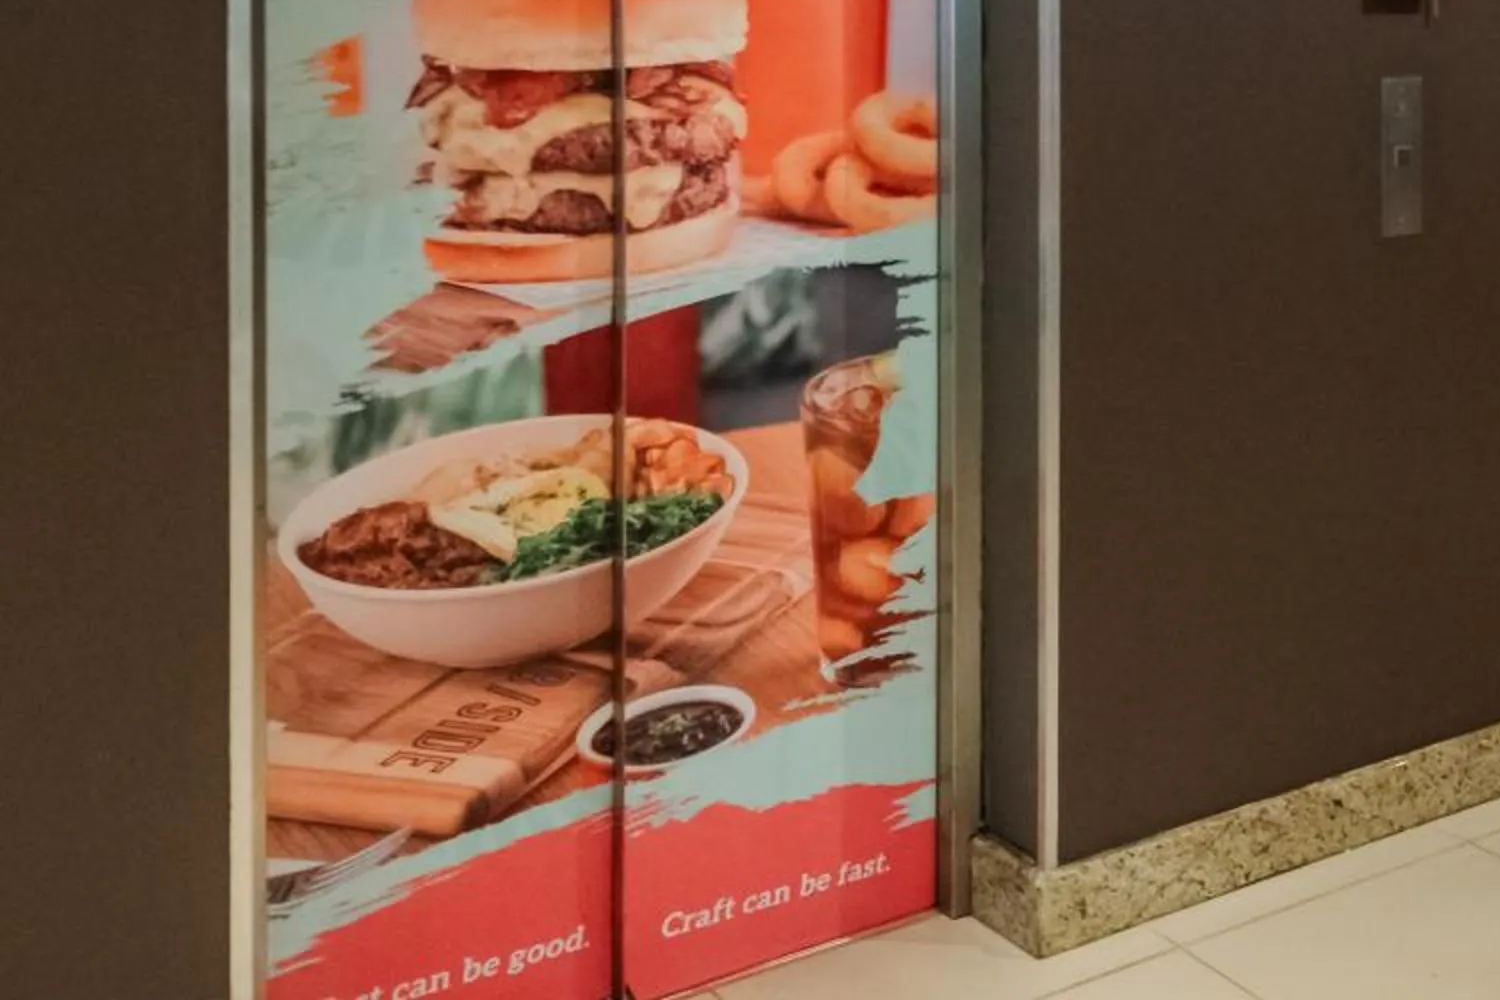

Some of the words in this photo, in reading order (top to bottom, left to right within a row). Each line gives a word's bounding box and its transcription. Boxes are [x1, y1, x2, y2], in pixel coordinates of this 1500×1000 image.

[661, 896, 736, 939] Craft
[742, 884, 792, 915] can
[799, 872, 833, 897] be
[836, 852, 891, 887] fast.
[391, 970, 450, 1000] can
[462, 956, 501, 984] be
[506, 923, 591, 976] good.
